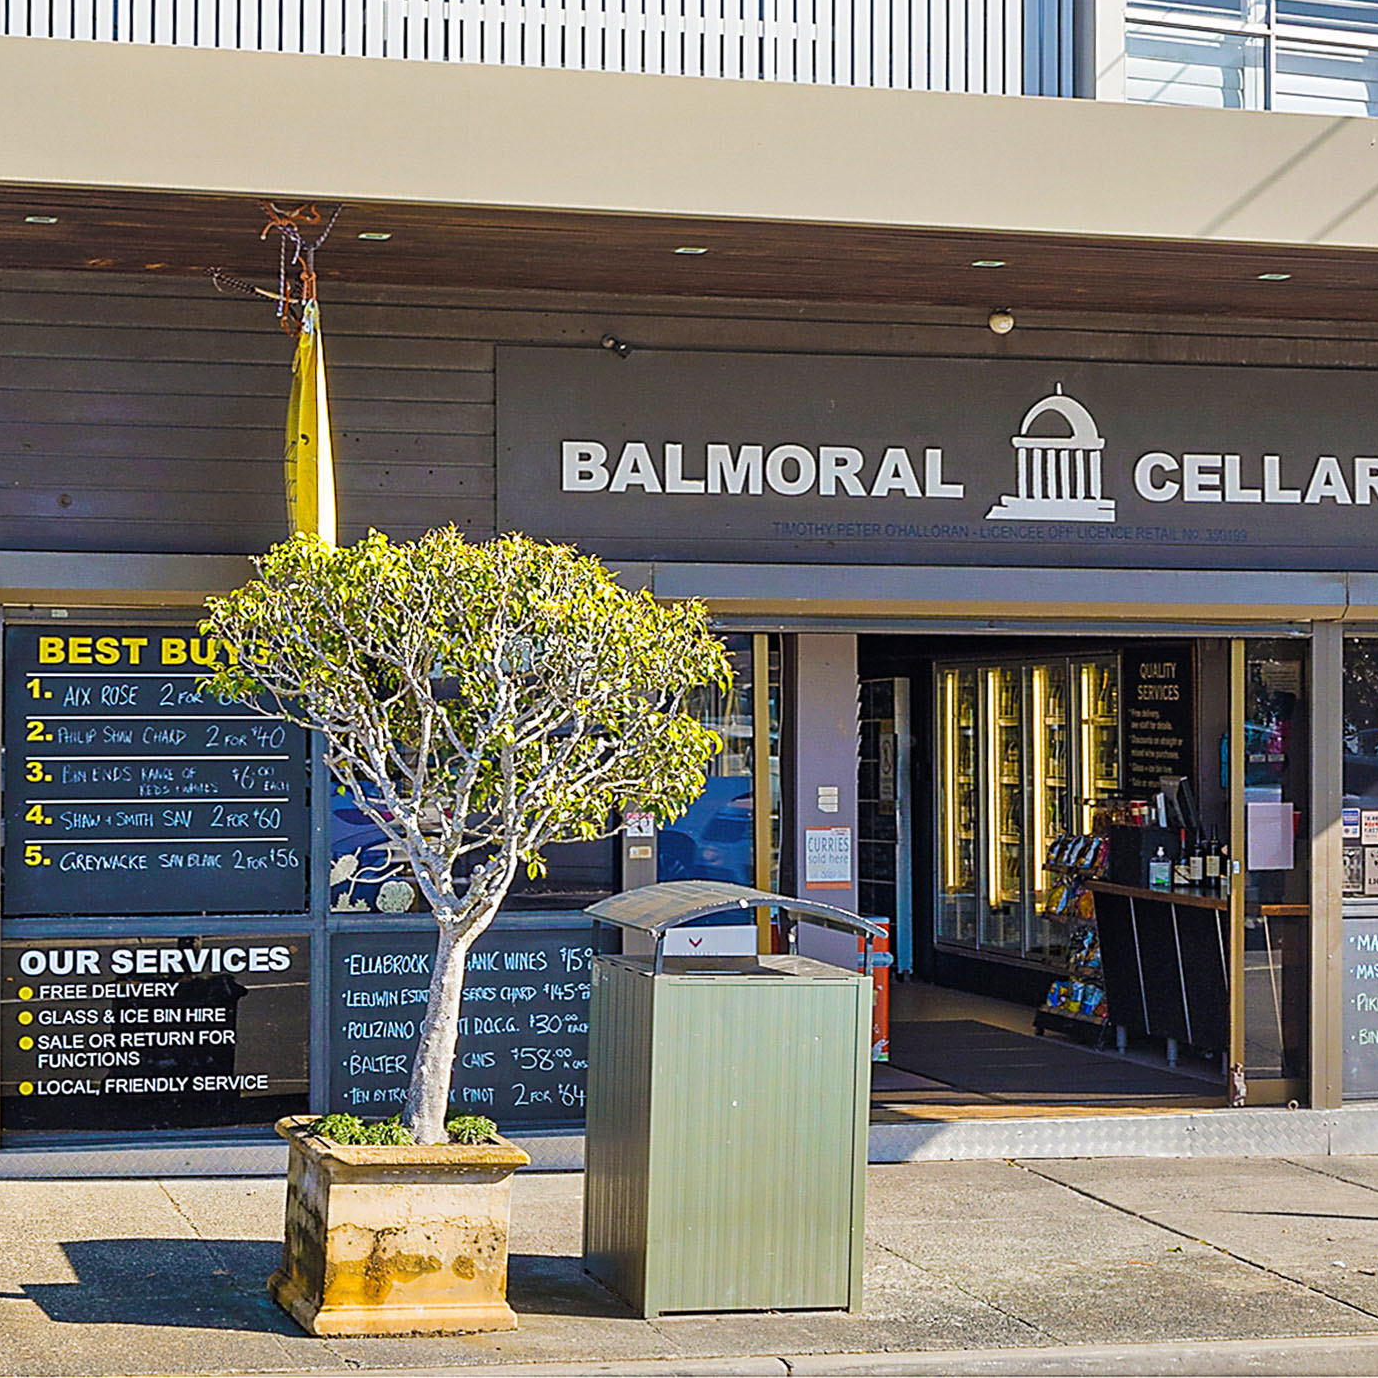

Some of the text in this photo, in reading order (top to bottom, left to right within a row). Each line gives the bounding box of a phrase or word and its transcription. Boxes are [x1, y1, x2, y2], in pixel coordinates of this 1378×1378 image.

[561, 440, 964, 499] BALMORAL
[774, 522, 833, 537] TIMOTHY
[836, 523, 881, 537] PETER
[885, 523, 969, 539] O'HALLORAN
[1077, 526, 1133, 541] LICENCE
[1136, 527, 1177, 541] RETAIL
[39, 637, 148, 664] BEST
[1139, 662, 1177, 679] QUALITY
[26, 678, 52, 699] 1.
[63, 685, 92, 707] AIX
[102, 684, 139, 707] ROSE
[159, 683, 175, 706] 2
[178, 691, 204, 704] FOR
[1137, 685, 1180, 701] SERVICES
[26, 721, 53, 741] 2.
[205, 725, 220, 747] 2
[224, 734, 247, 746] FOR
[26, 762, 52, 782] 3.
[25, 804, 52, 825] 4.
[60, 811, 101, 830] SHAW
[116, 812, 154, 827] SMITH
[162, 810, 193, 828] SAV
[210, 805, 224, 827] 2
[226, 813, 249, 827] FOR
[808, 837, 849, 852] CURRIES
[24, 845, 51, 866] 5.
[232, 850, 246, 869] 2
[246, 856, 268, 869] FOR
[808, 853, 849, 864] sold here
[20, 946, 292, 975] OUR SERVICES
[504, 951, 548, 971] WINES
[39, 982, 179, 999] FREE DELIVERY
[39, 1007, 227, 1025] GLASS & ICE BIN HIRE
[38, 1030, 236, 1050] SALE OR RETURN FOR
[38, 1051, 140, 1069] FUNCTIONS
[350, 1054, 408, 1076] BALTER
[37, 1074, 269, 1097] LOCAL, FRIENDLY SERVICE
[511, 1083, 529, 1106] 2
